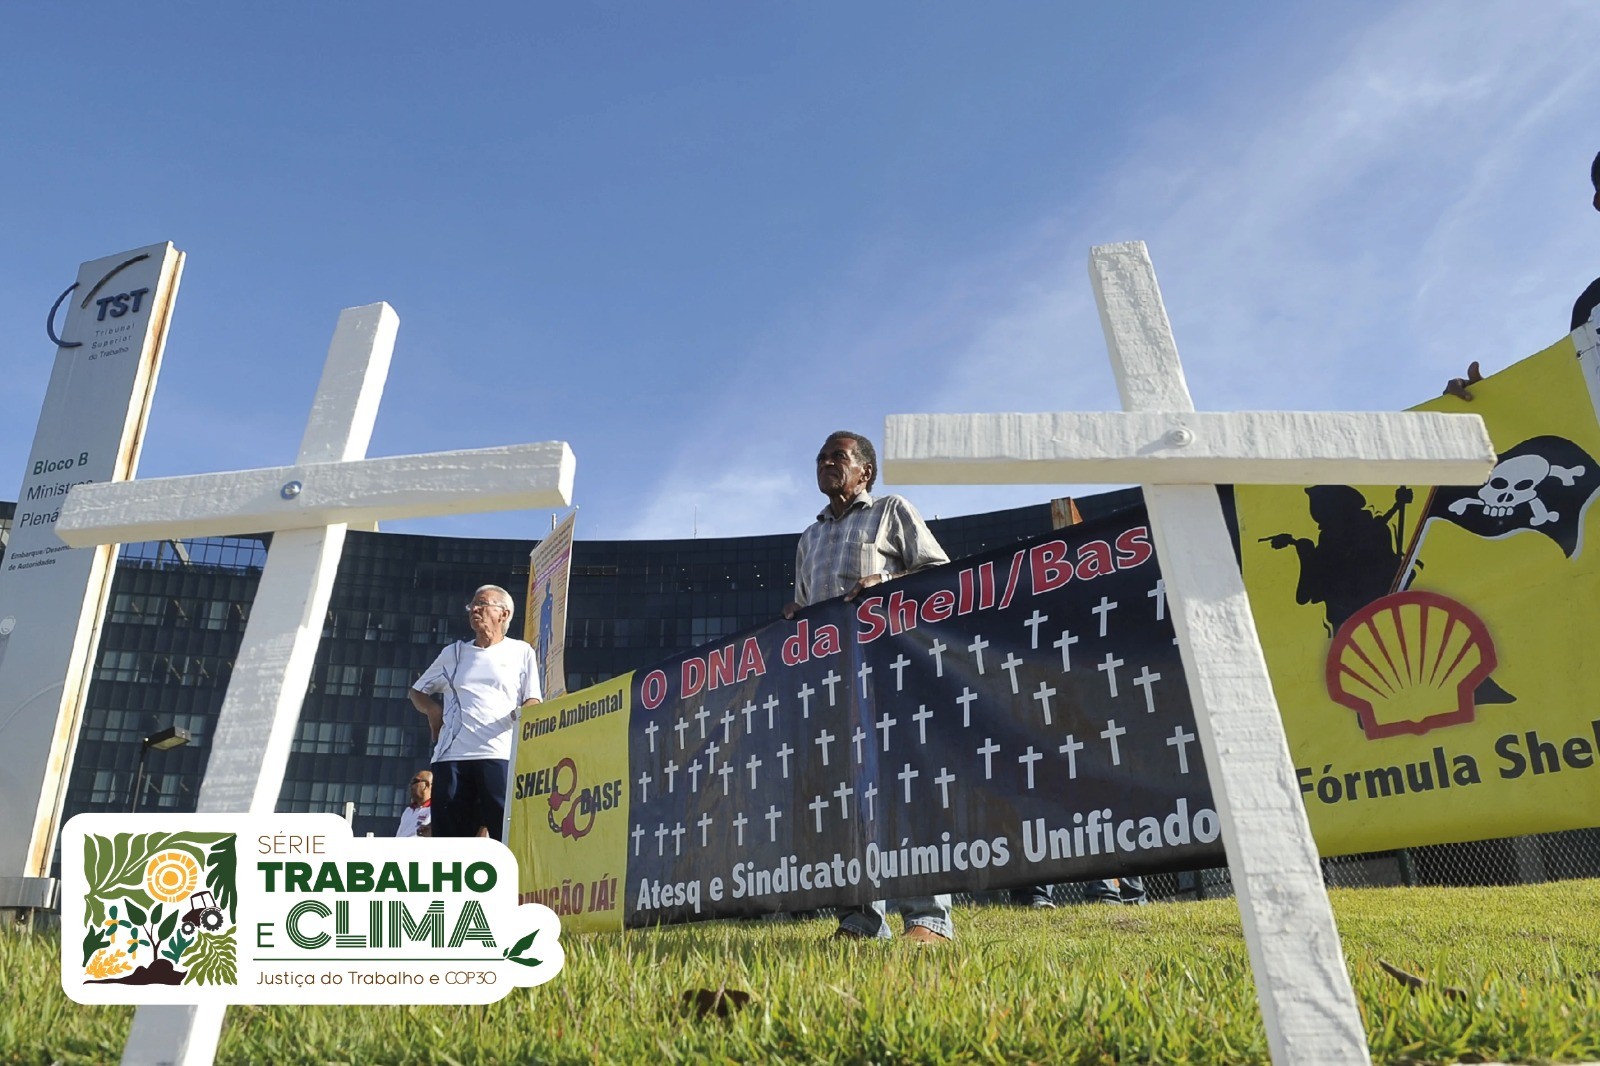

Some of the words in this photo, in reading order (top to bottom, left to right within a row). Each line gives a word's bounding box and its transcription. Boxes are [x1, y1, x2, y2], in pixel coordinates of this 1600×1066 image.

[96, 287, 149, 321] TST
[91, 335, 132, 350] Superior
[95, 322, 135, 337] Tribunal
[88, 353, 98, 361] do
[100, 346, 129, 358] Trabalho
[33, 457, 74, 475] Bloco
[78, 452, 89, 467] B
[8, 563, 16, 571] de
[17, 559, 56, 570] Autoridades
[641, 669, 668, 710] O
[681, 636, 767, 700] DNA
[781, 618, 842, 667] da
[522, 717, 557, 742] Crime
[559, 689, 623, 730] Ambiental
[1295, 746, 1482, 804] Fórmula
[580, 779, 622, 816] BASF
[636, 878, 701, 914] Atesq
[709, 876, 724, 901] e
[732, 853, 861, 899] Sindicato
[865, 831, 1010, 889] Químicos
[588, 873, 618, 912] JÁ!
